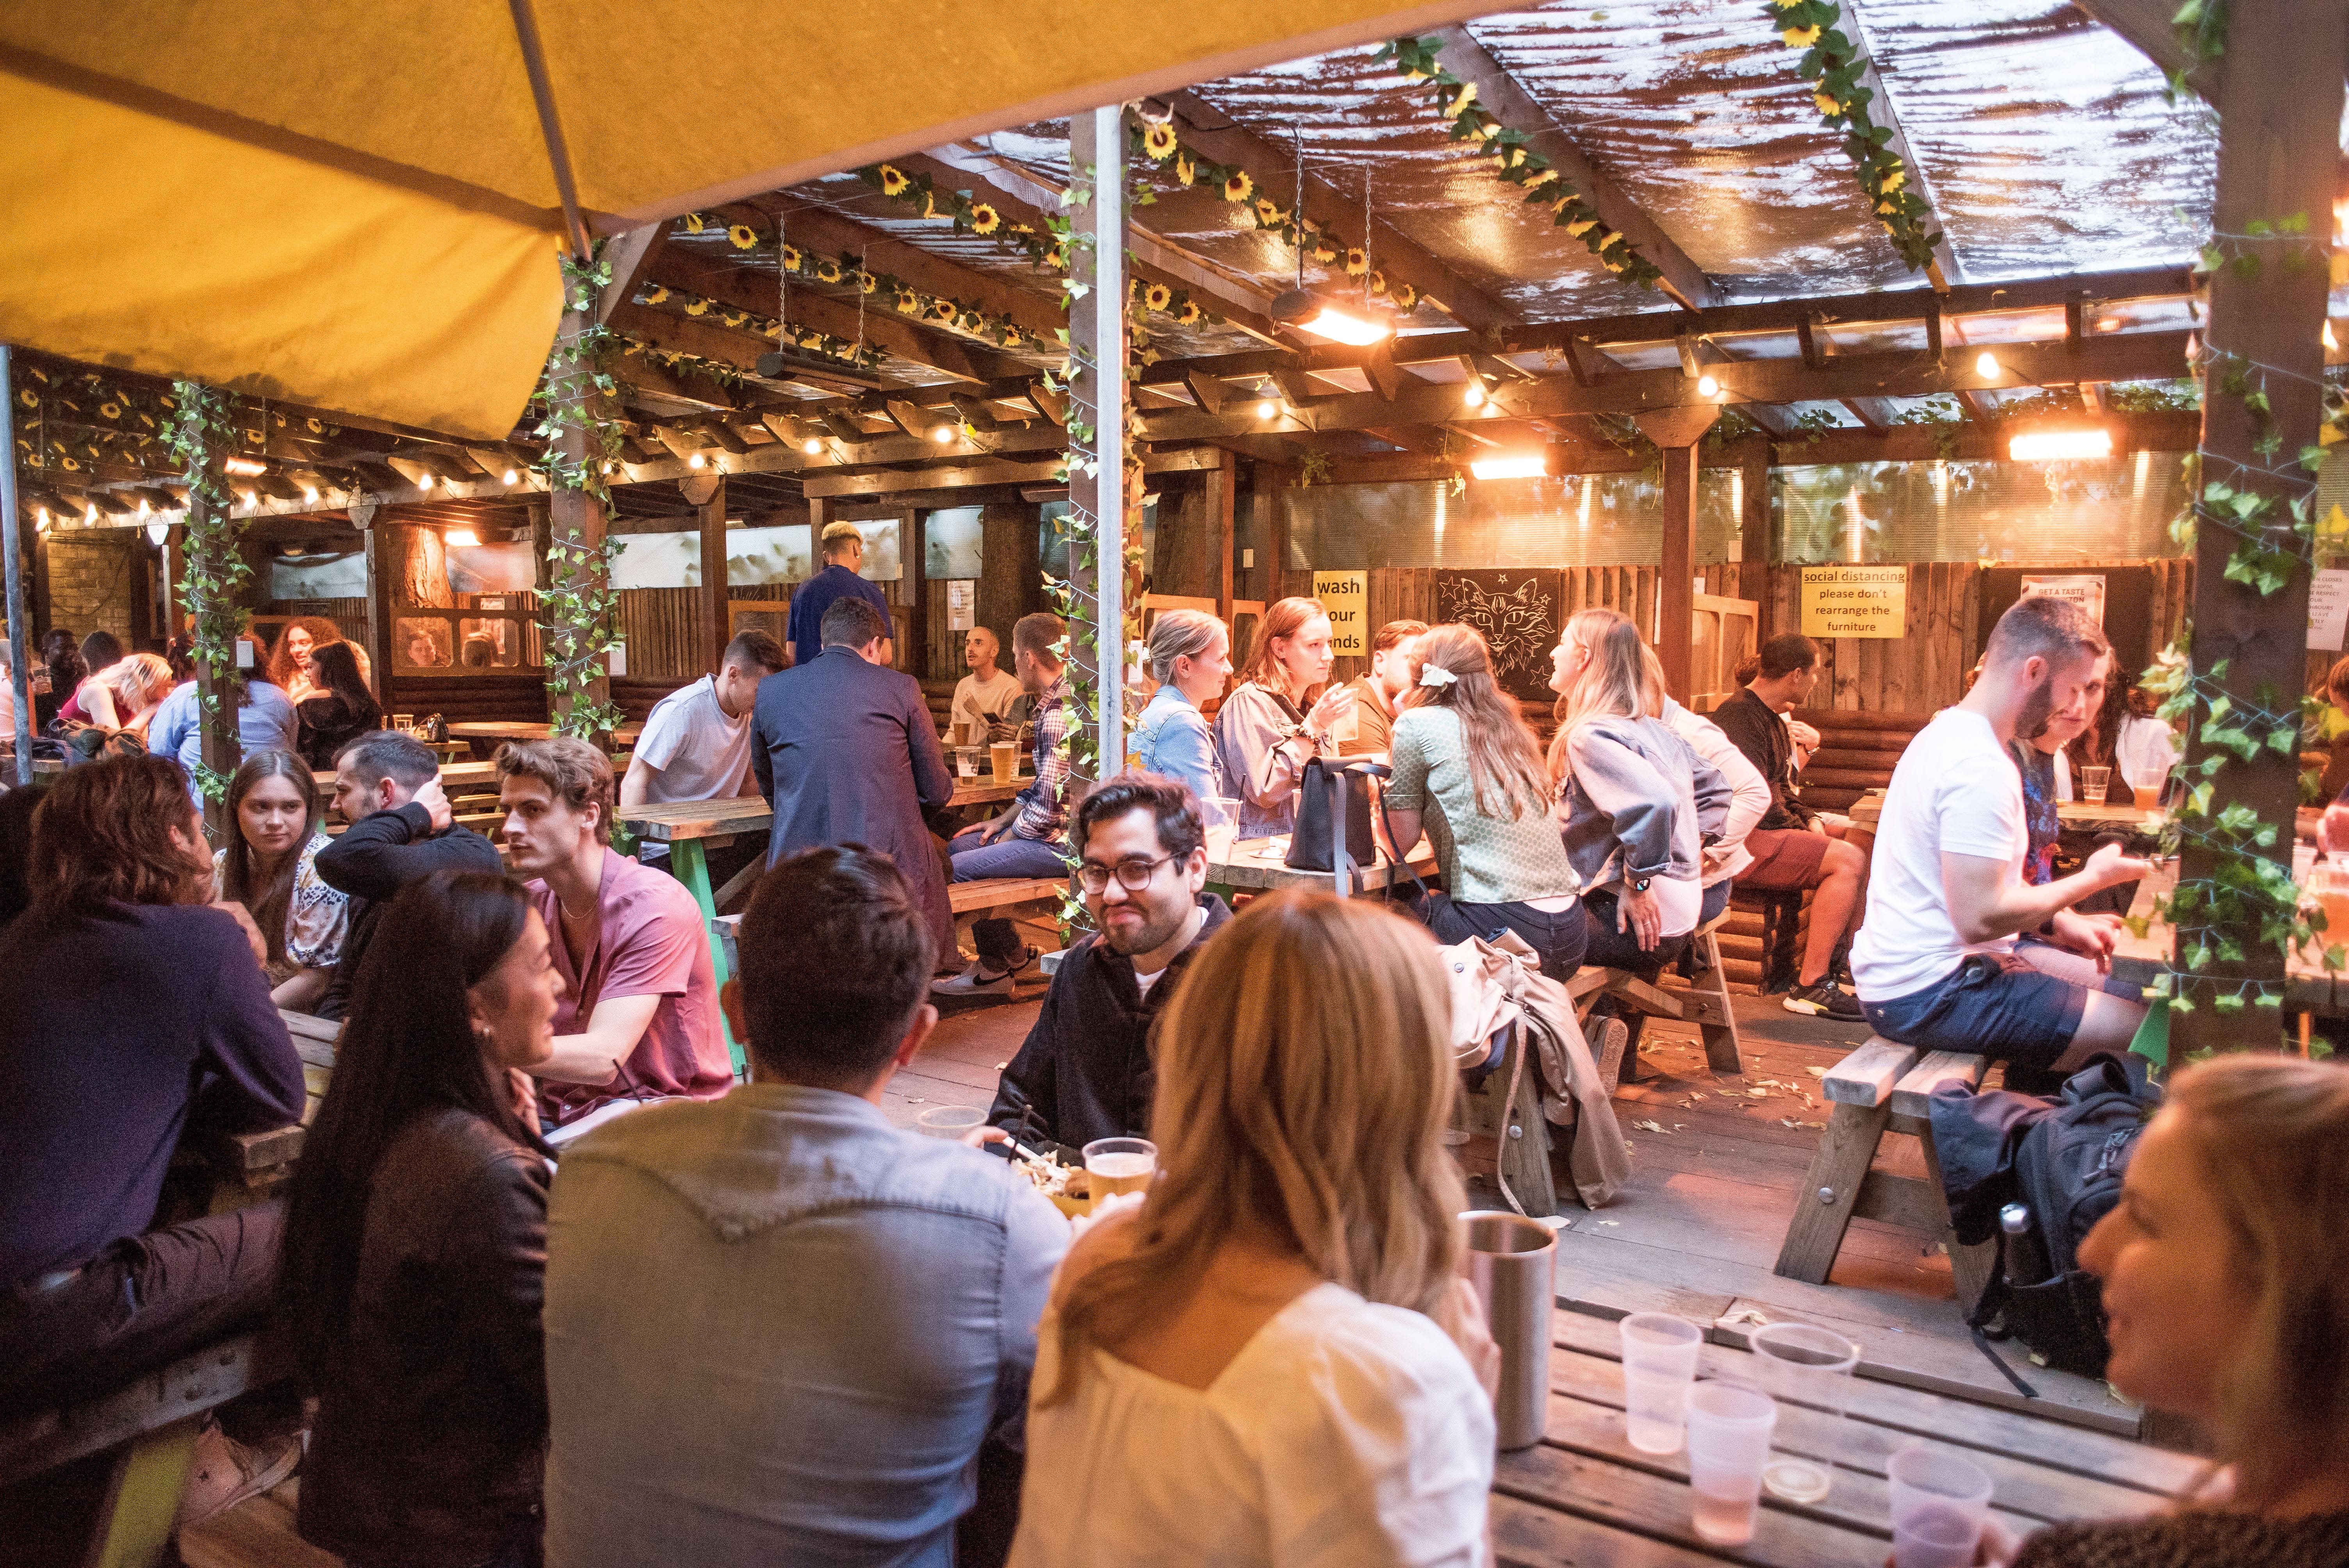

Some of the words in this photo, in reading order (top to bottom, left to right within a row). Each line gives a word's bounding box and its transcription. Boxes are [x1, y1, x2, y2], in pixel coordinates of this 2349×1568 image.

[1804, 571, 1837, 581] social
[1841, 571, 1905, 583] distancing
[1317, 577, 1360, 593] wash
[1820, 589, 1854, 600] please
[1857, 589, 1887, 598] don’t
[1329, 611, 1356, 622] our
[1816, 608, 1868, 617] rearrange
[1872, 606, 1890, 615] the
[1827, 622, 1876, 631] furniture
[1330, 634, 1360, 648] nds
